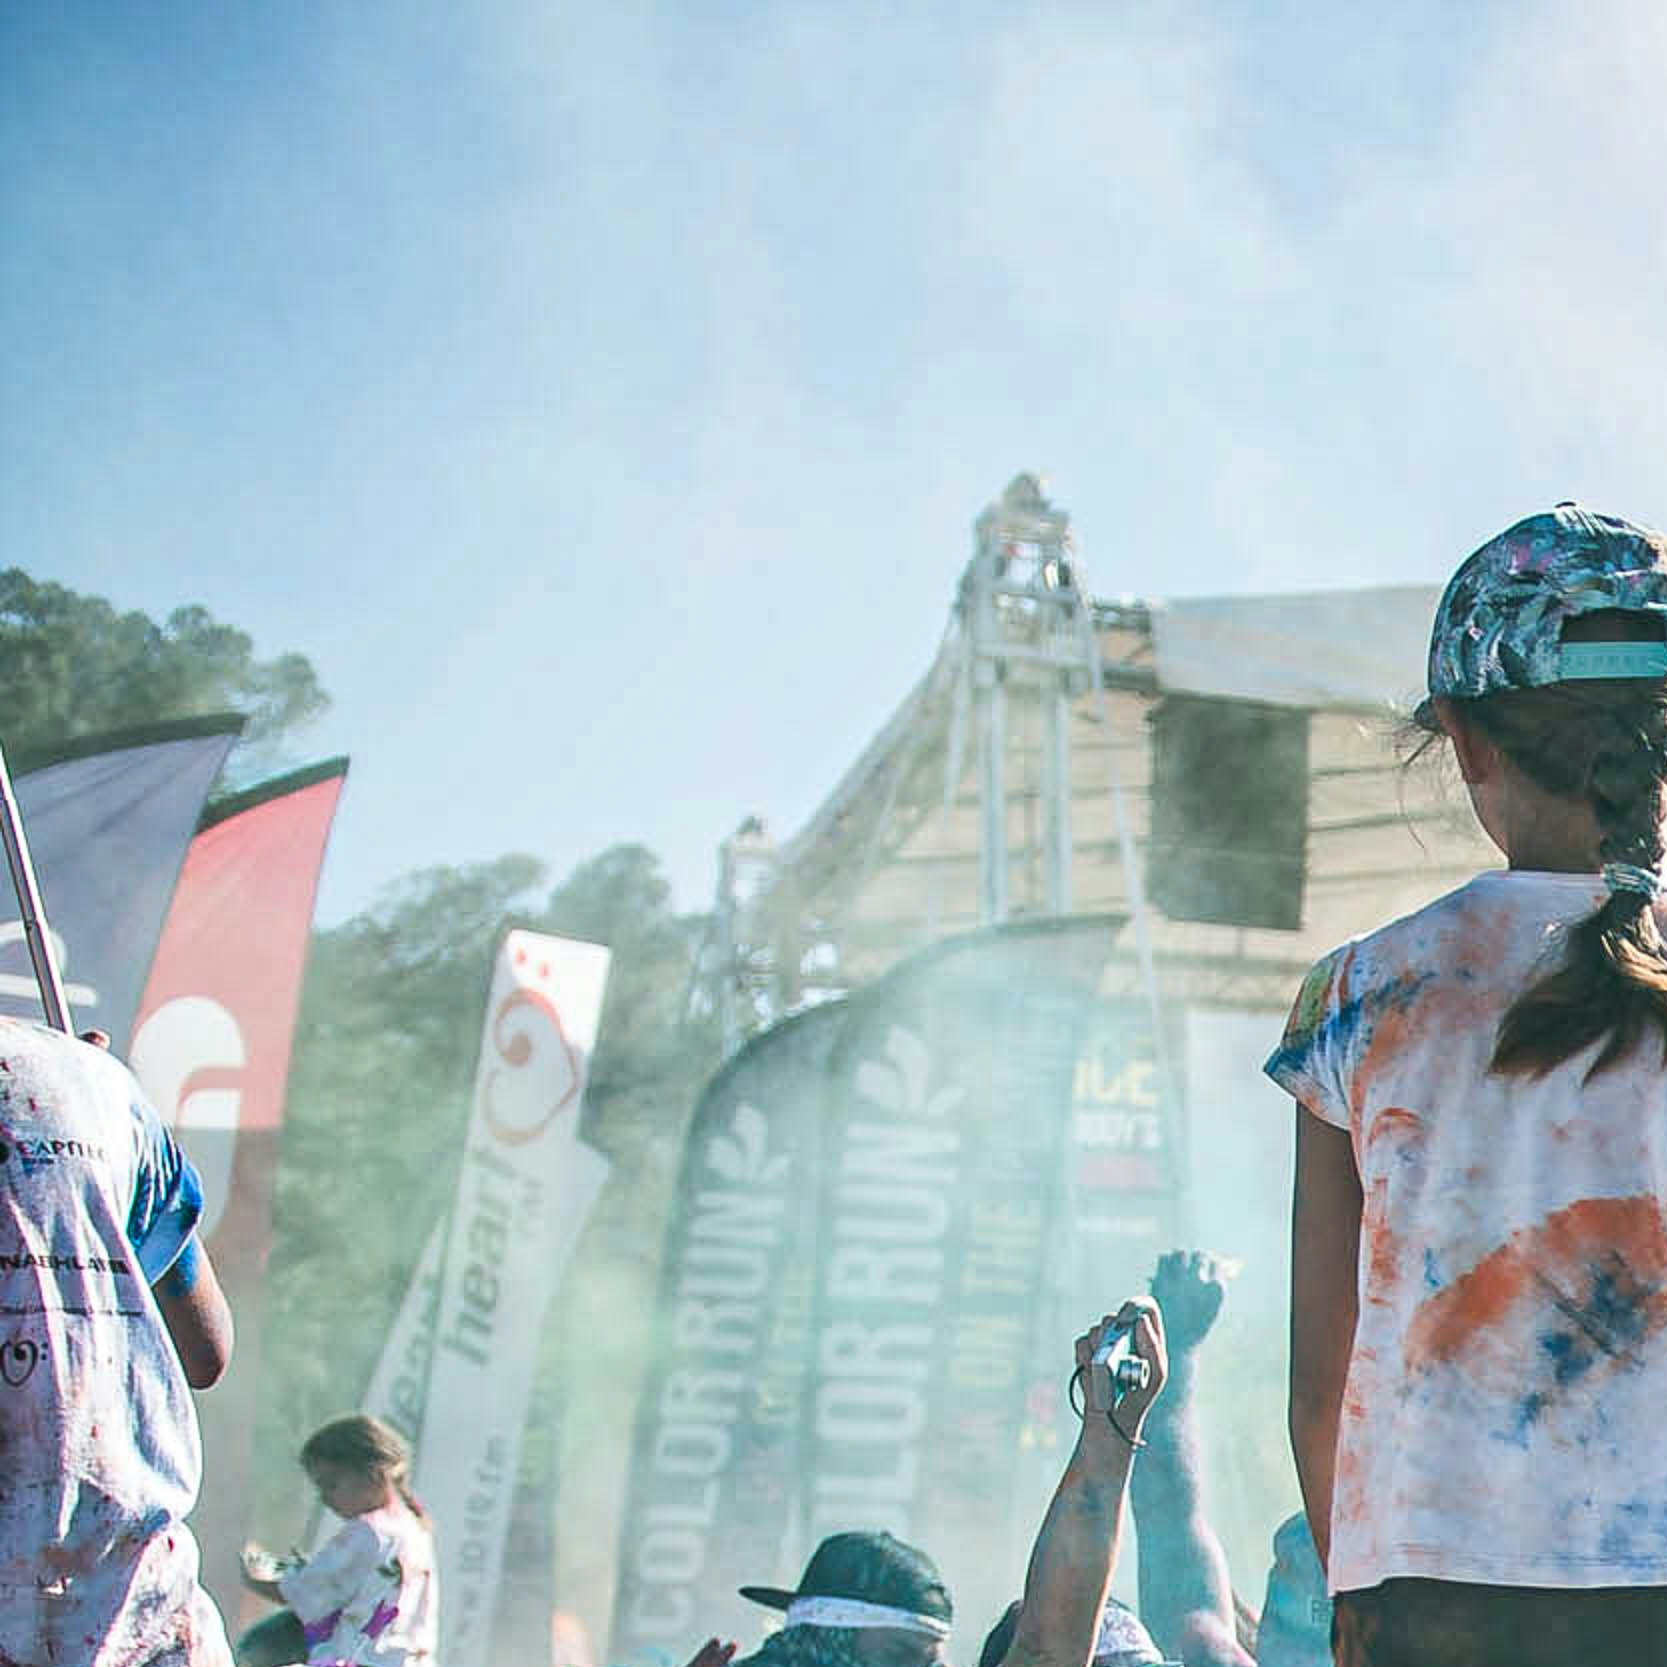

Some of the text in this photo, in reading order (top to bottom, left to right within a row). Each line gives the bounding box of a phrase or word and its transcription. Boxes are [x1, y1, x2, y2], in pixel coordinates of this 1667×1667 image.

[670, 1188, 789, 1362] RUN
[826, 1120, 963, 1304] RUN
[632, 1364, 743, 1642] COLOR
